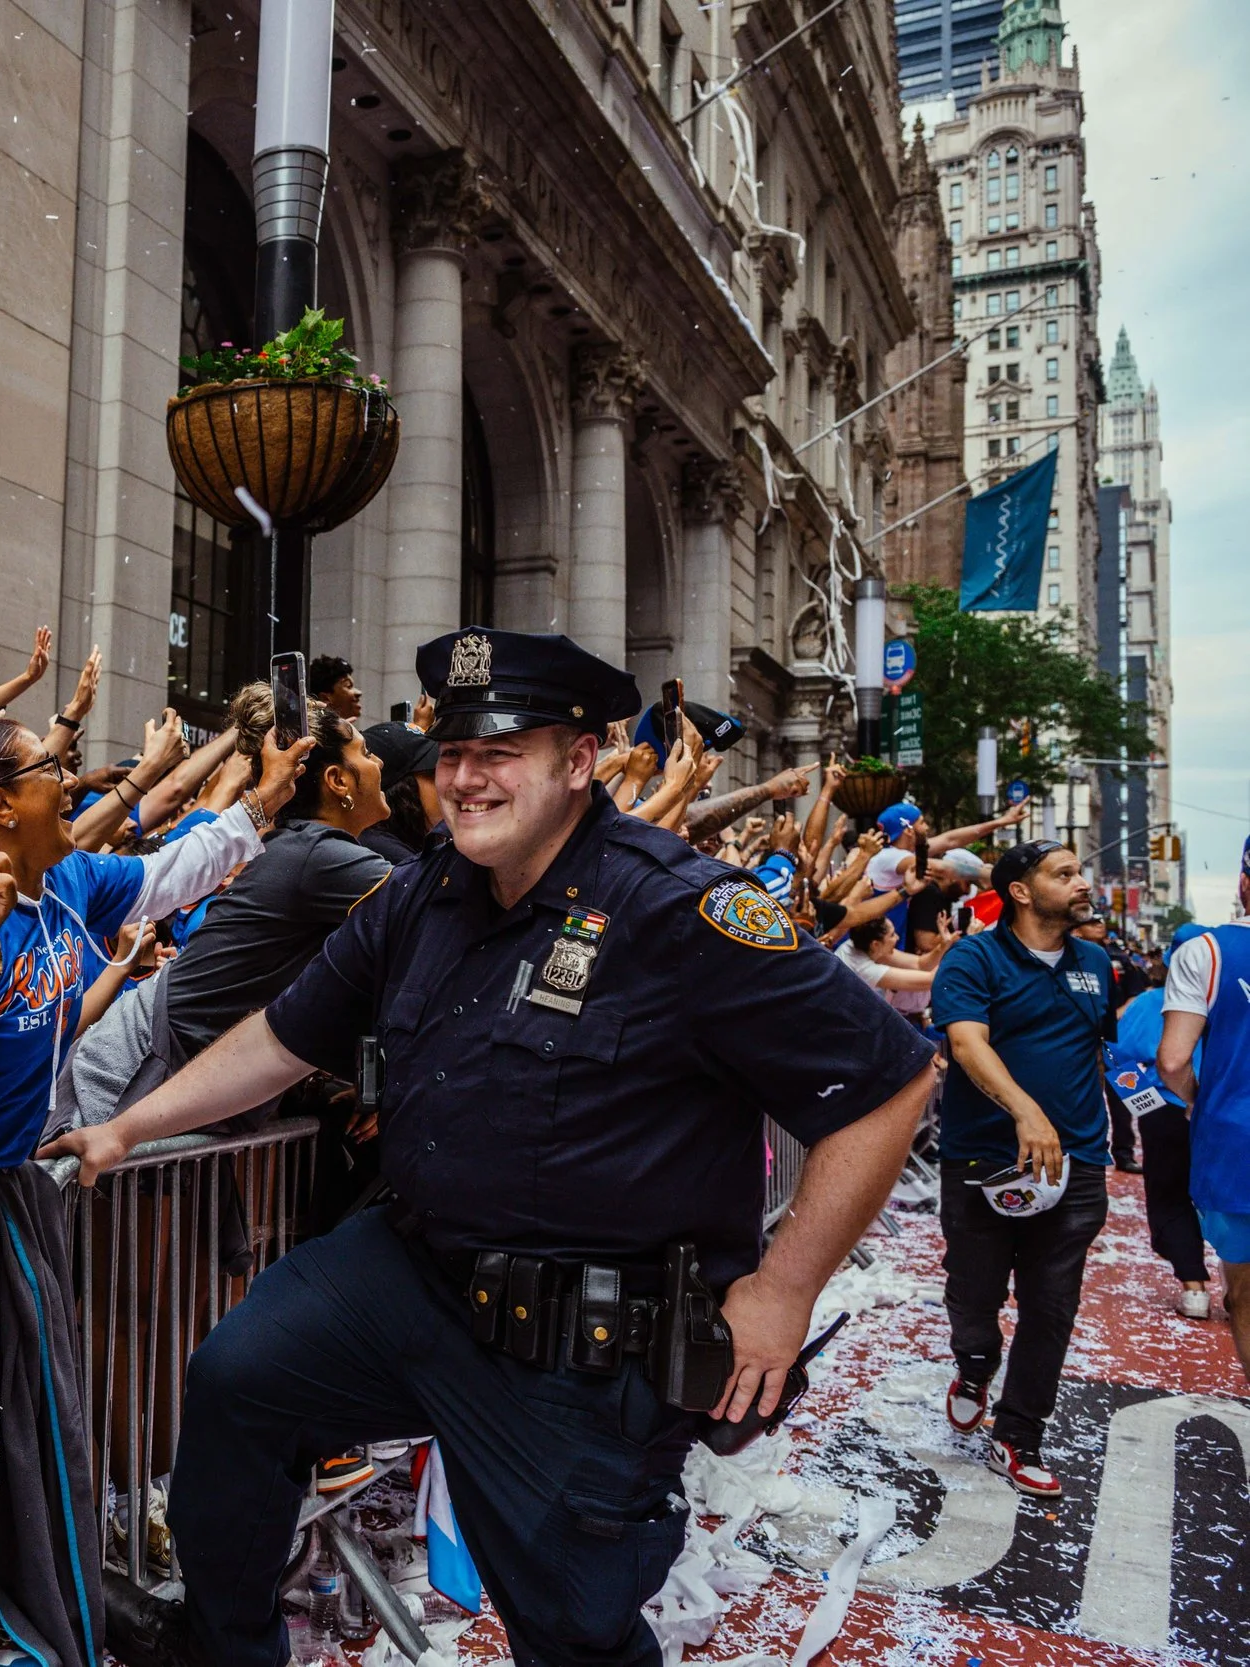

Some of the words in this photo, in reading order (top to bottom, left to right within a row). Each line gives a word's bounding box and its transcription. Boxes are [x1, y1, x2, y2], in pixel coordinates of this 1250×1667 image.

[169, 612, 189, 648] CE
[709, 879, 733, 903] POLICE
[757, 890, 776, 909] YORK
[712, 882, 752, 923] DEPARTMENT
[775, 910, 790, 928] NEW
[727, 926, 753, 940] CITY
[755, 936, 770, 945] OF
[17, 1009, 51, 1032] EST.
[1131, 1092, 1152, 1105] EVENT
[1136, 1099, 1156, 1112] STAFF
